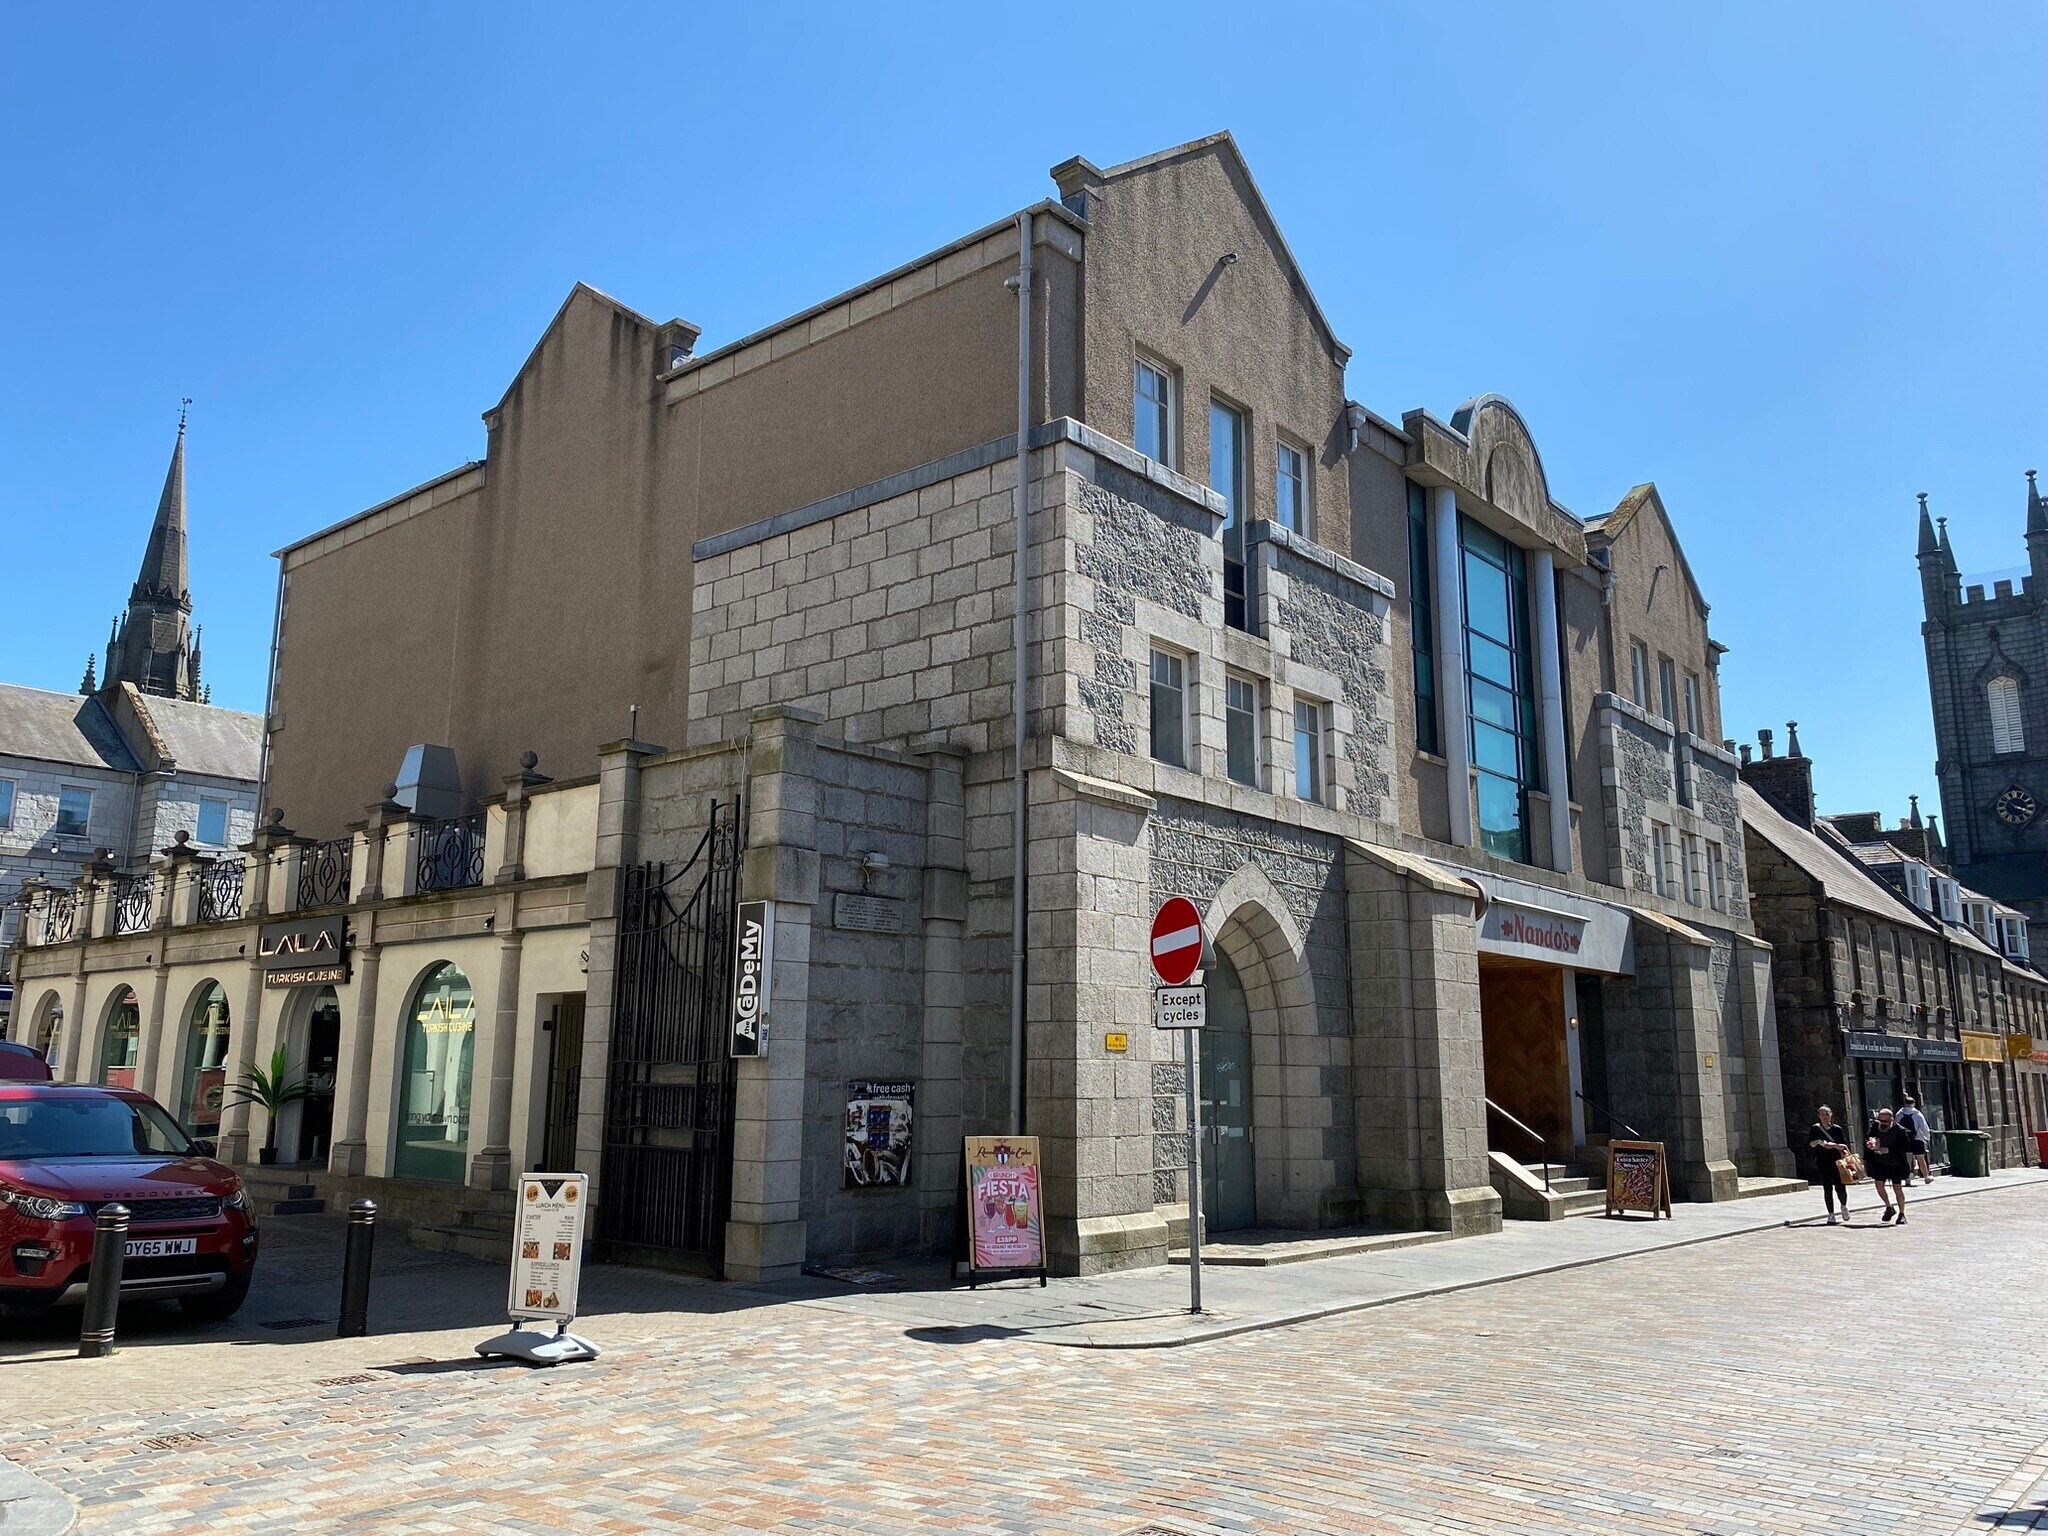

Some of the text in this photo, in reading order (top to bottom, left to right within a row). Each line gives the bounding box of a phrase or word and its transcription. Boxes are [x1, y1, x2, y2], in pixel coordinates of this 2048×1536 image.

[1513, 914, 1569, 951] Nando's
[267, 969, 343, 984] TURKISH CUISINE
[1162, 992, 1201, 1007] Except
[1163, 1009, 1199, 1023] cycles
[873, 1083, 911, 1094] free cash
[104, 1189, 205, 1199] DISCOVERY
[978, 1180, 1028, 1199] FIESTA
[165, 1240, 191, 1254] WWJ
